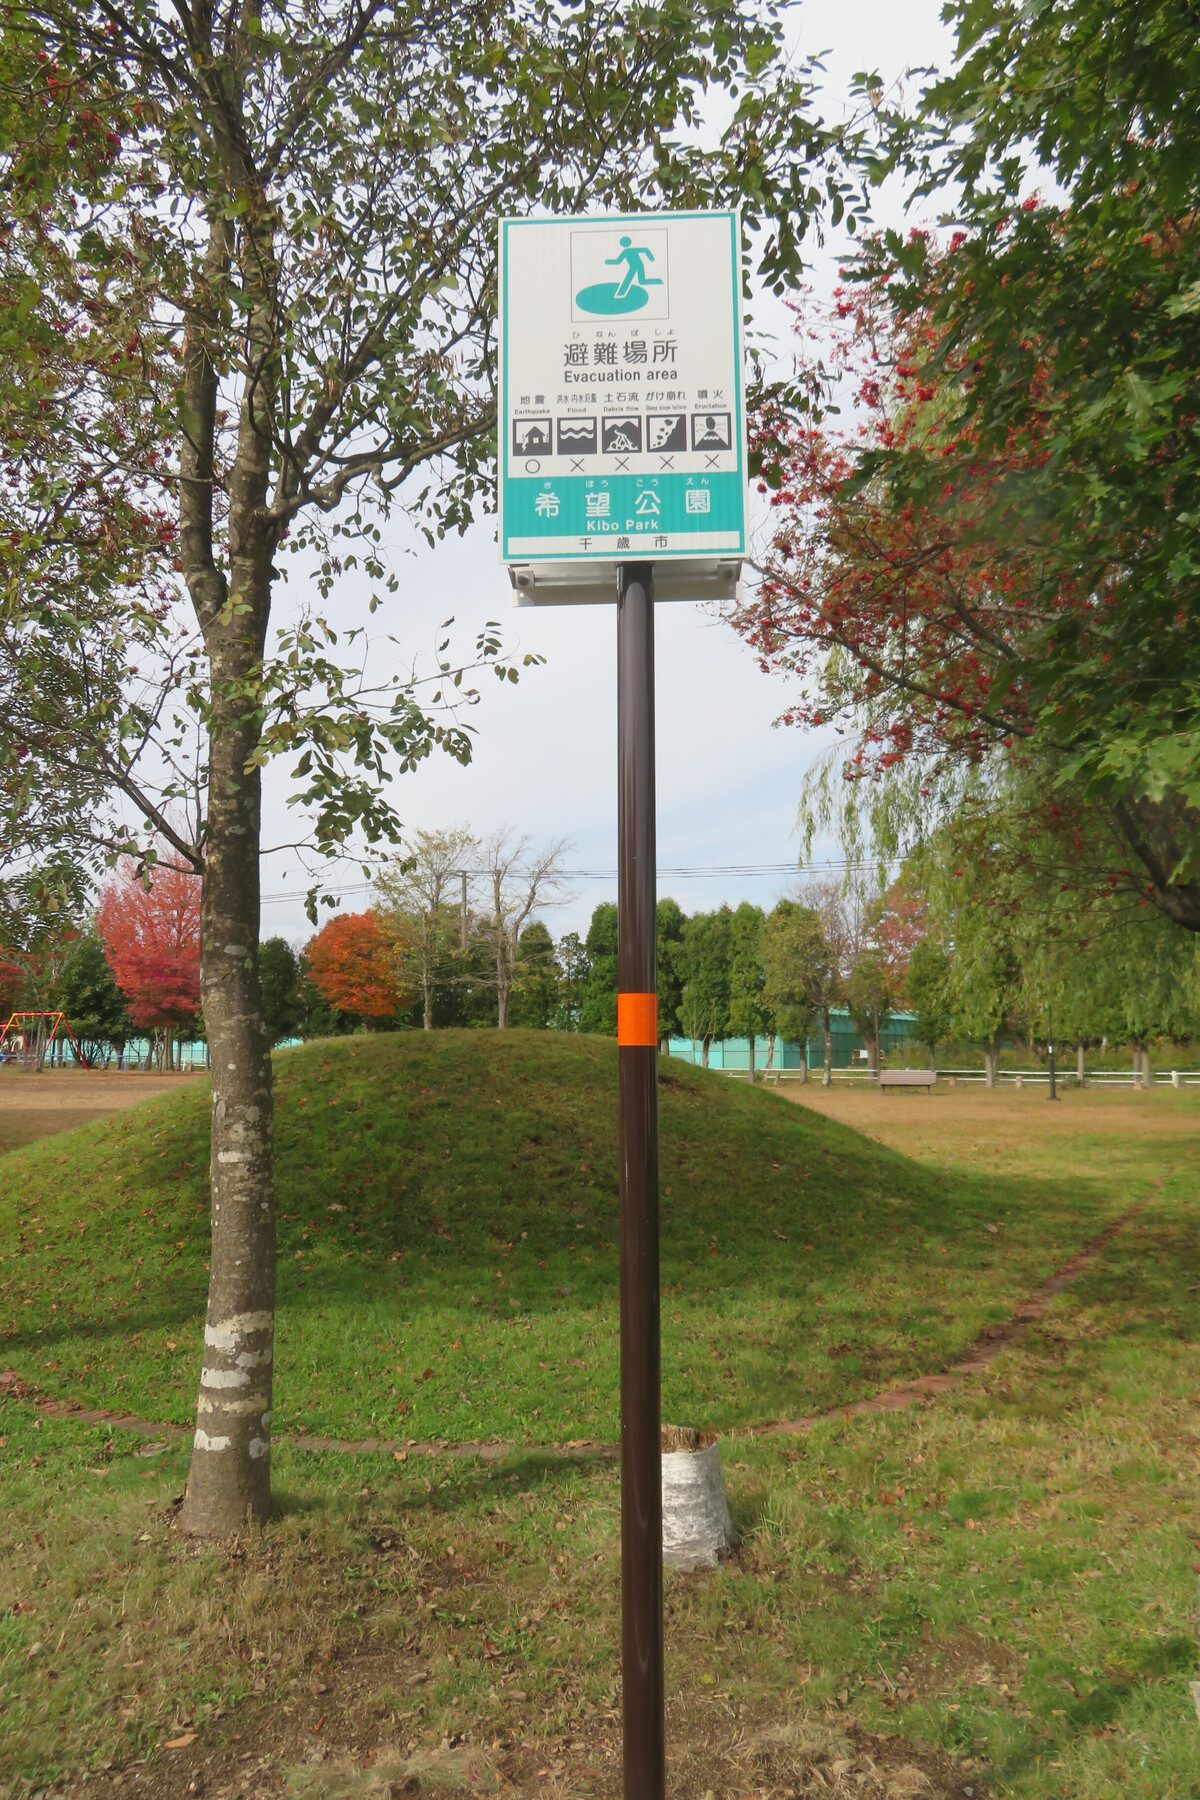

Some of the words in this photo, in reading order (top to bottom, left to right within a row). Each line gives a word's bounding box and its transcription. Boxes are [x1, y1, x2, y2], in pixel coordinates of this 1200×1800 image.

[563, 339, 678, 367] 避難場所
[564, 369, 641, 383] Evacuation
[646, 370, 678, 381] area
[519, 394, 546, 405] 地震
[603, 391, 640, 403] 土石流
[645, 390, 687, 401] がけ崩れ
[697, 388, 724, 399] 噴火
[514, 408, 551, 416] Earthquake
[694, 402, 728, 410] Eructation
[534, 489, 711, 518] 希望公園
[586, 520, 620, 532] Kibo
[625, 519, 659, 531] Park
[578, 535, 669, 550] 千歳市
